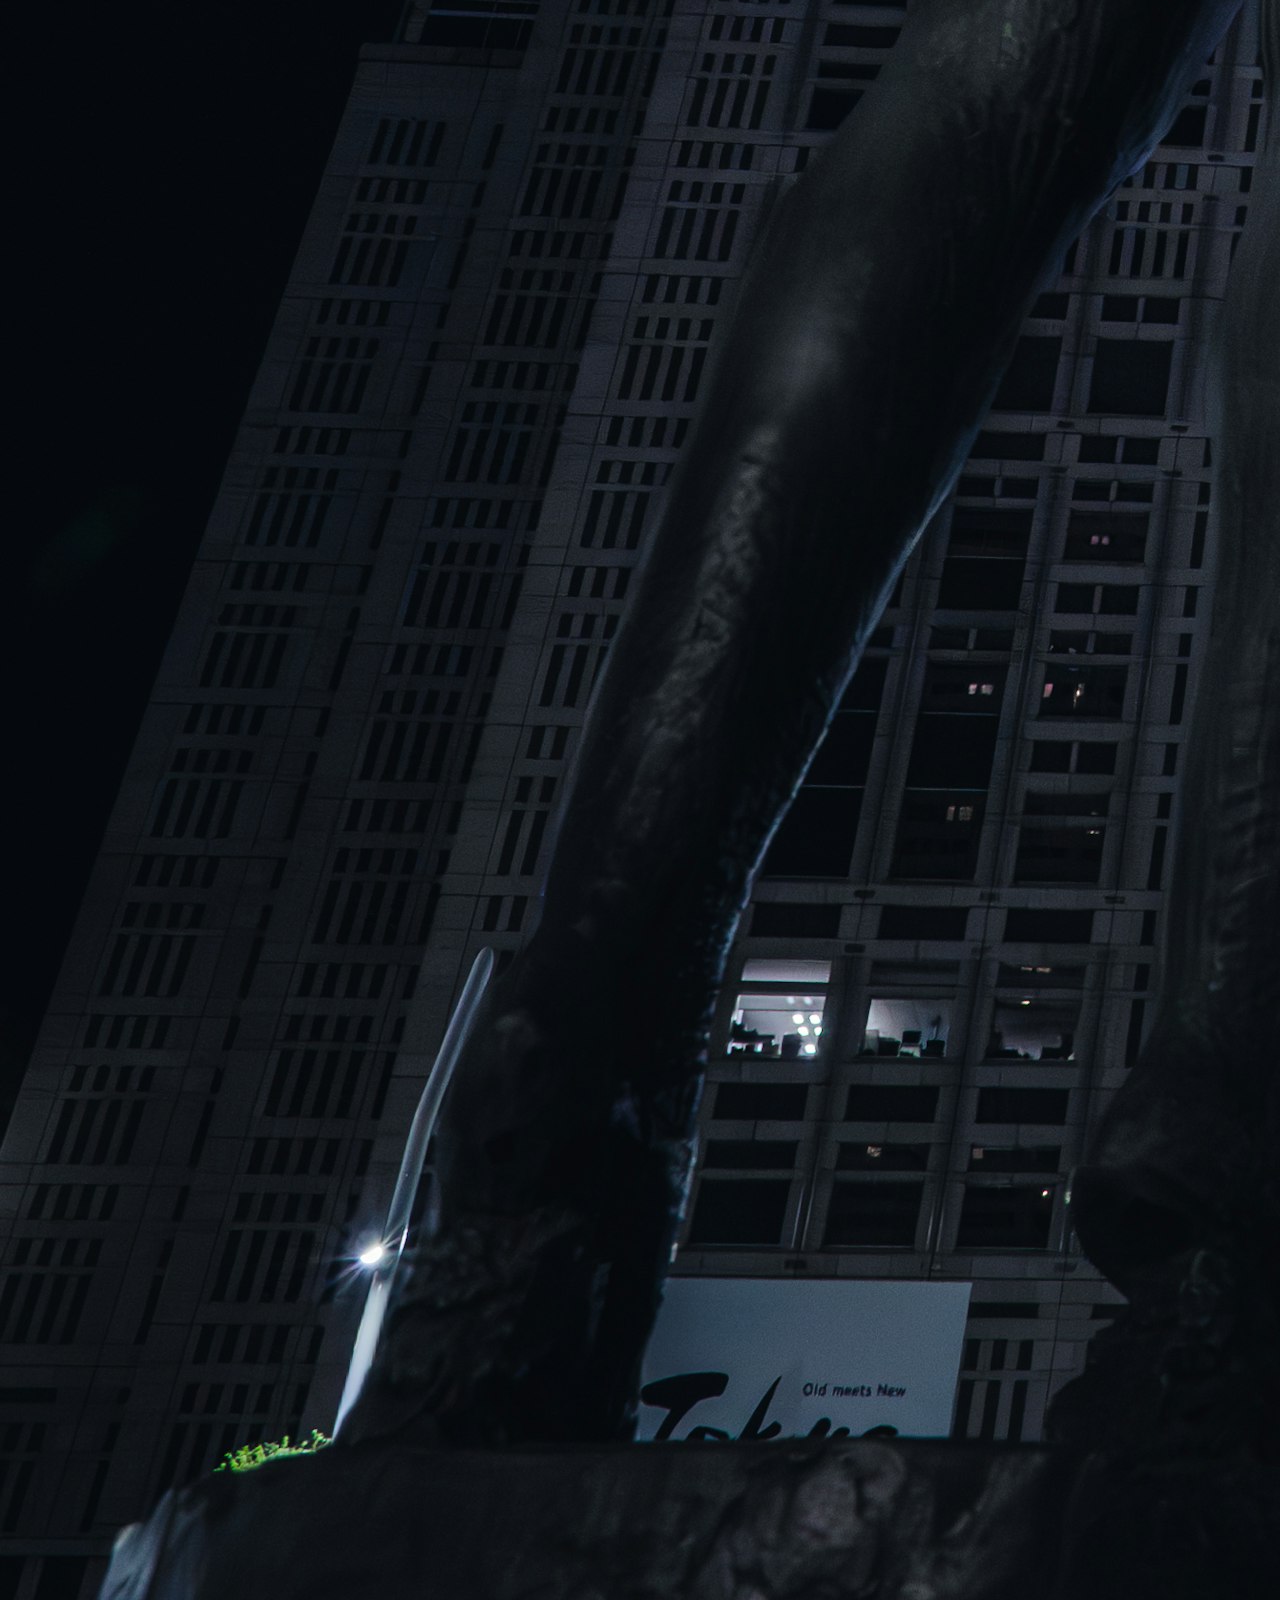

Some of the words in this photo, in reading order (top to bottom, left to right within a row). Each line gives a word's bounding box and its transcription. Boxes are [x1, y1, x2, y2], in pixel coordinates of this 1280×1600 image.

[803, 1382, 828, 1397] Old
[832, 1385, 872, 1397] meets
[877, 1383, 907, 1397] New
